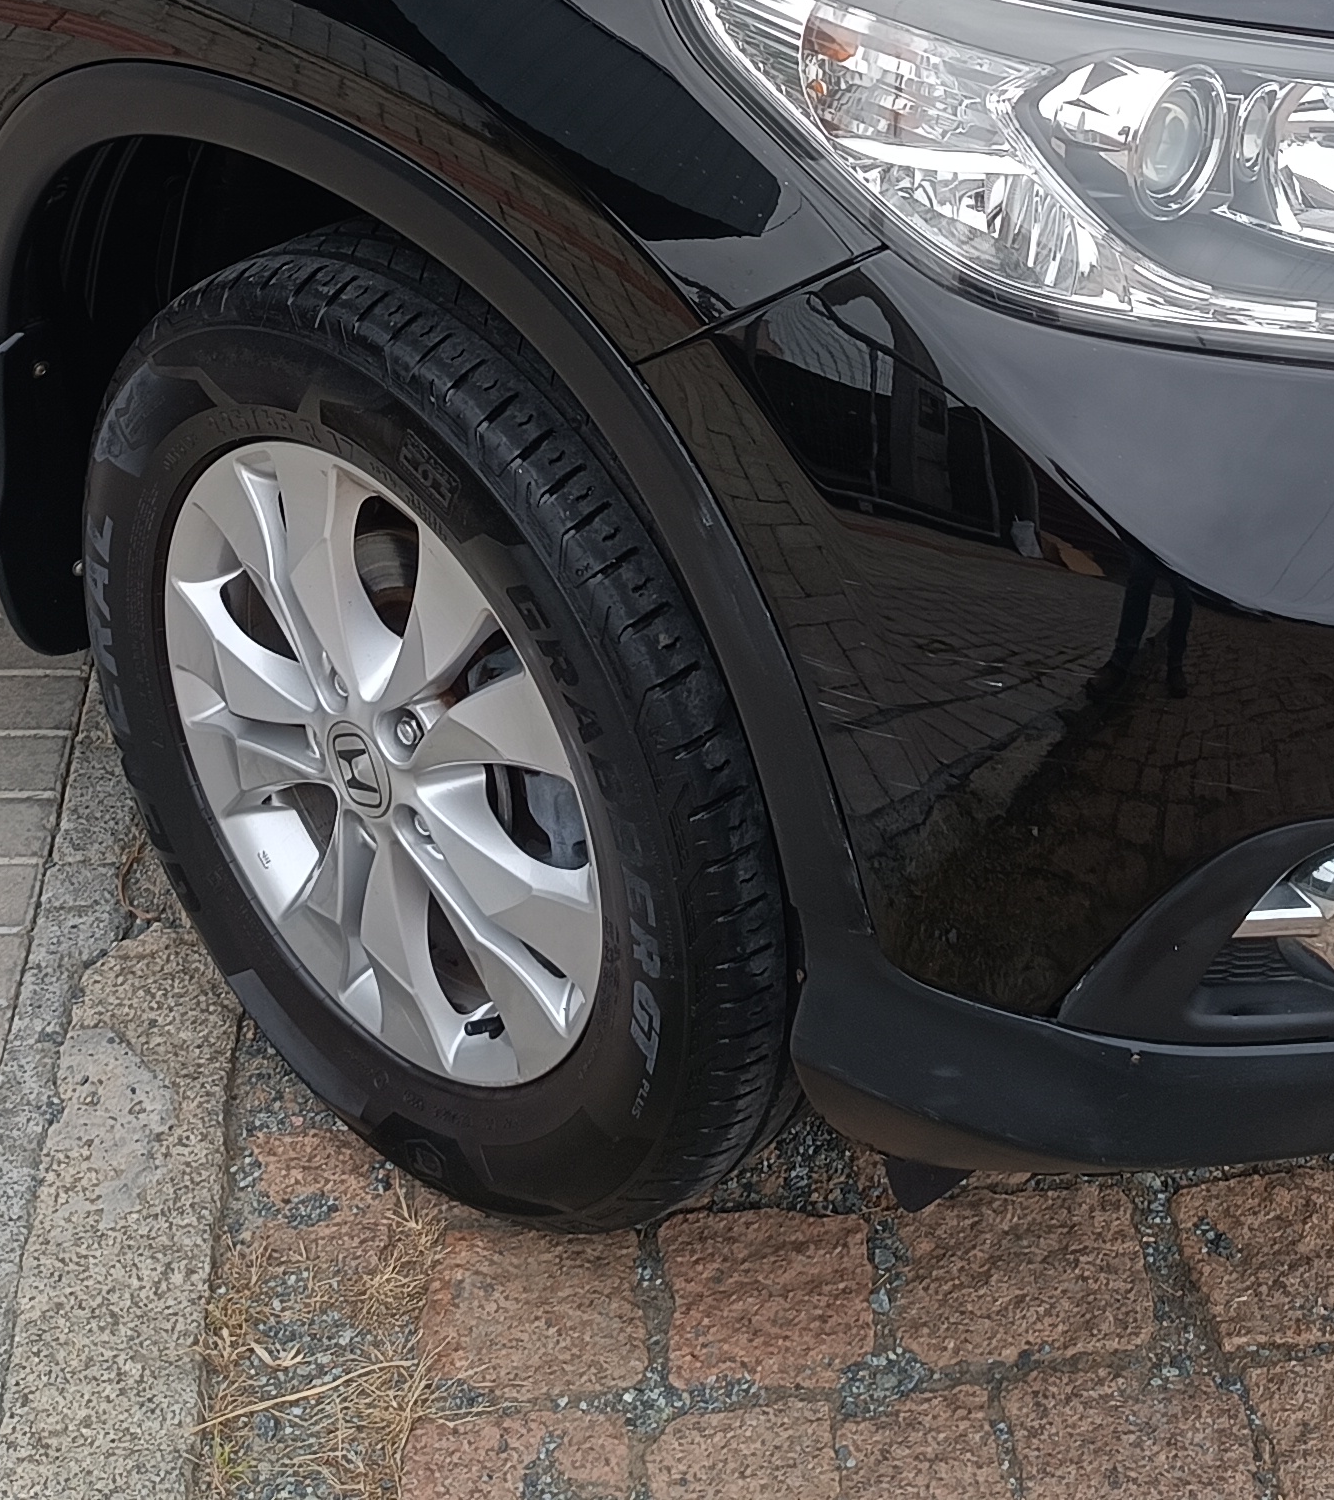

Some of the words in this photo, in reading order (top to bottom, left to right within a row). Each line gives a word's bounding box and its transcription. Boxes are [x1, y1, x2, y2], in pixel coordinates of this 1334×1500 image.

[505, 584, 661, 979] GRABBER
[629, 980, 661, 1076] GT
[631, 1078, 651, 1120] PLUS
